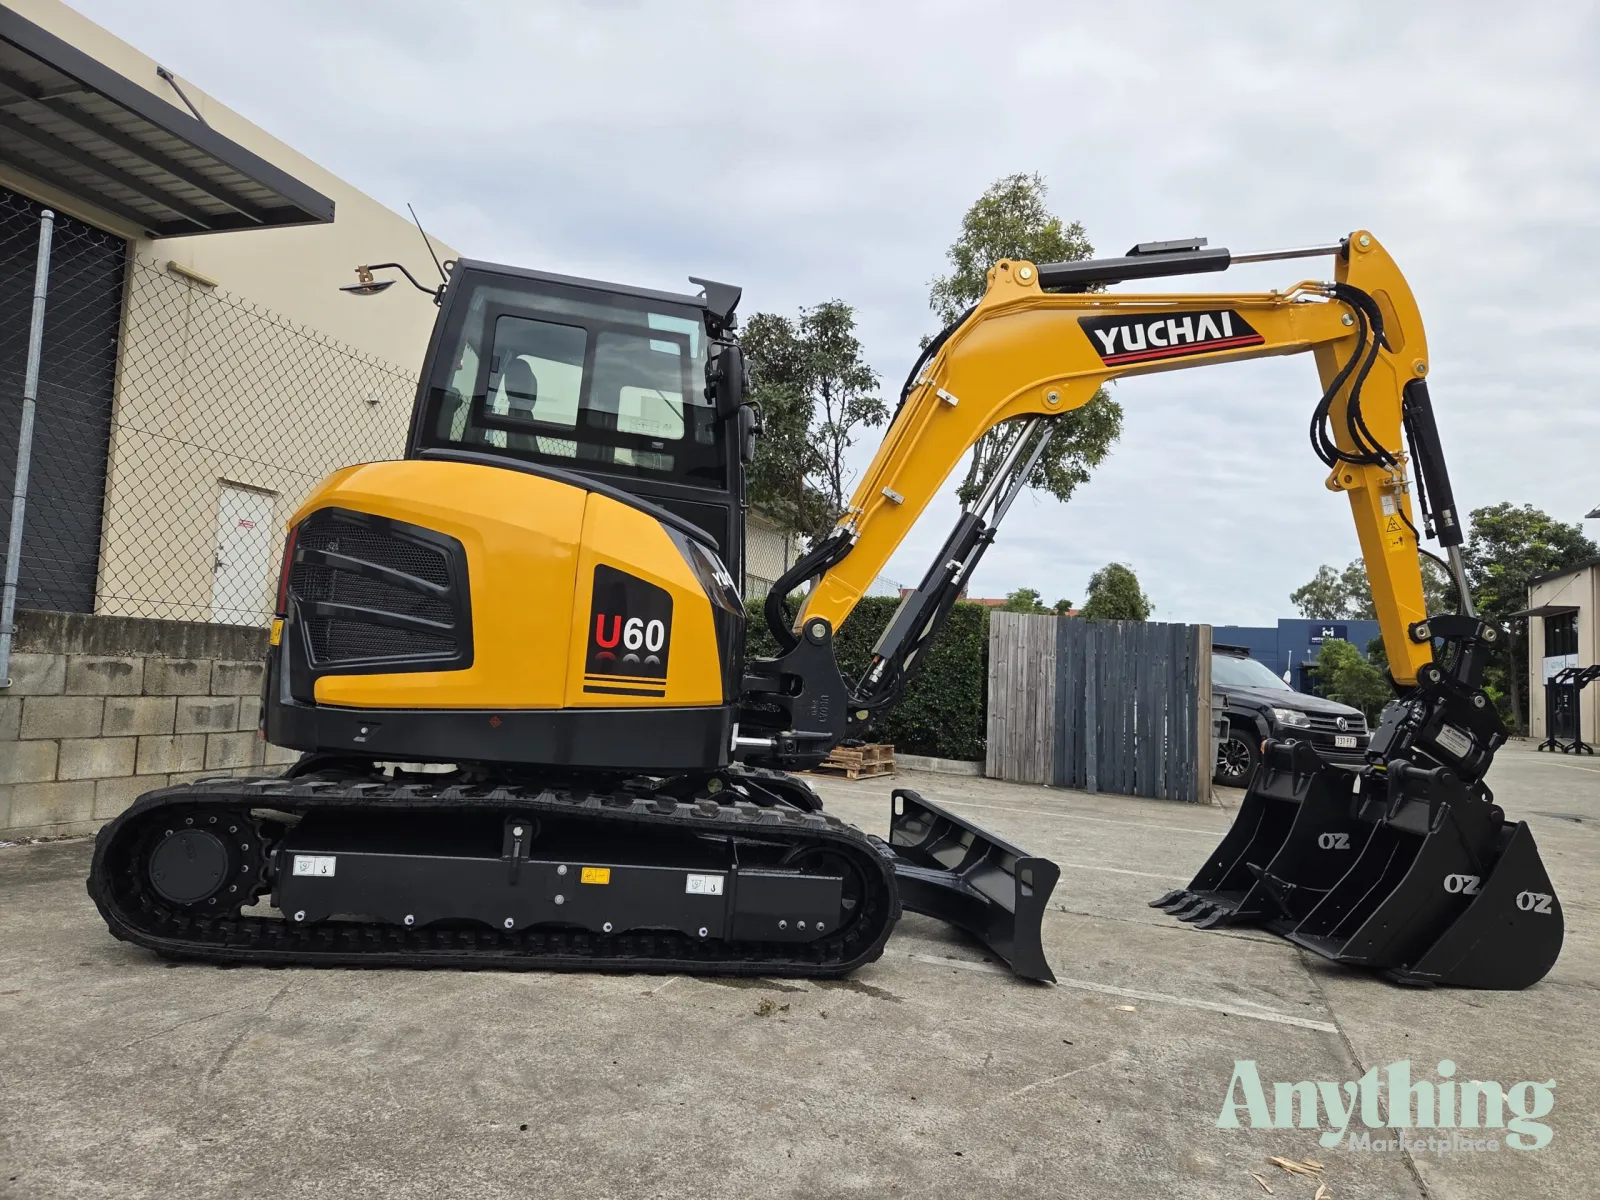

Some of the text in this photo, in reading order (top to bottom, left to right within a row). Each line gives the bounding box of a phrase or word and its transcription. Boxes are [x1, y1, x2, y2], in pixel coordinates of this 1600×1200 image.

[1094, 311, 1233, 355] YUCHAI
[596, 613, 665, 652] U60
[1318, 832, 1350, 850] OZ
[1443, 873, 1481, 895] OZ
[1516, 890, 1553, 915] OZ
